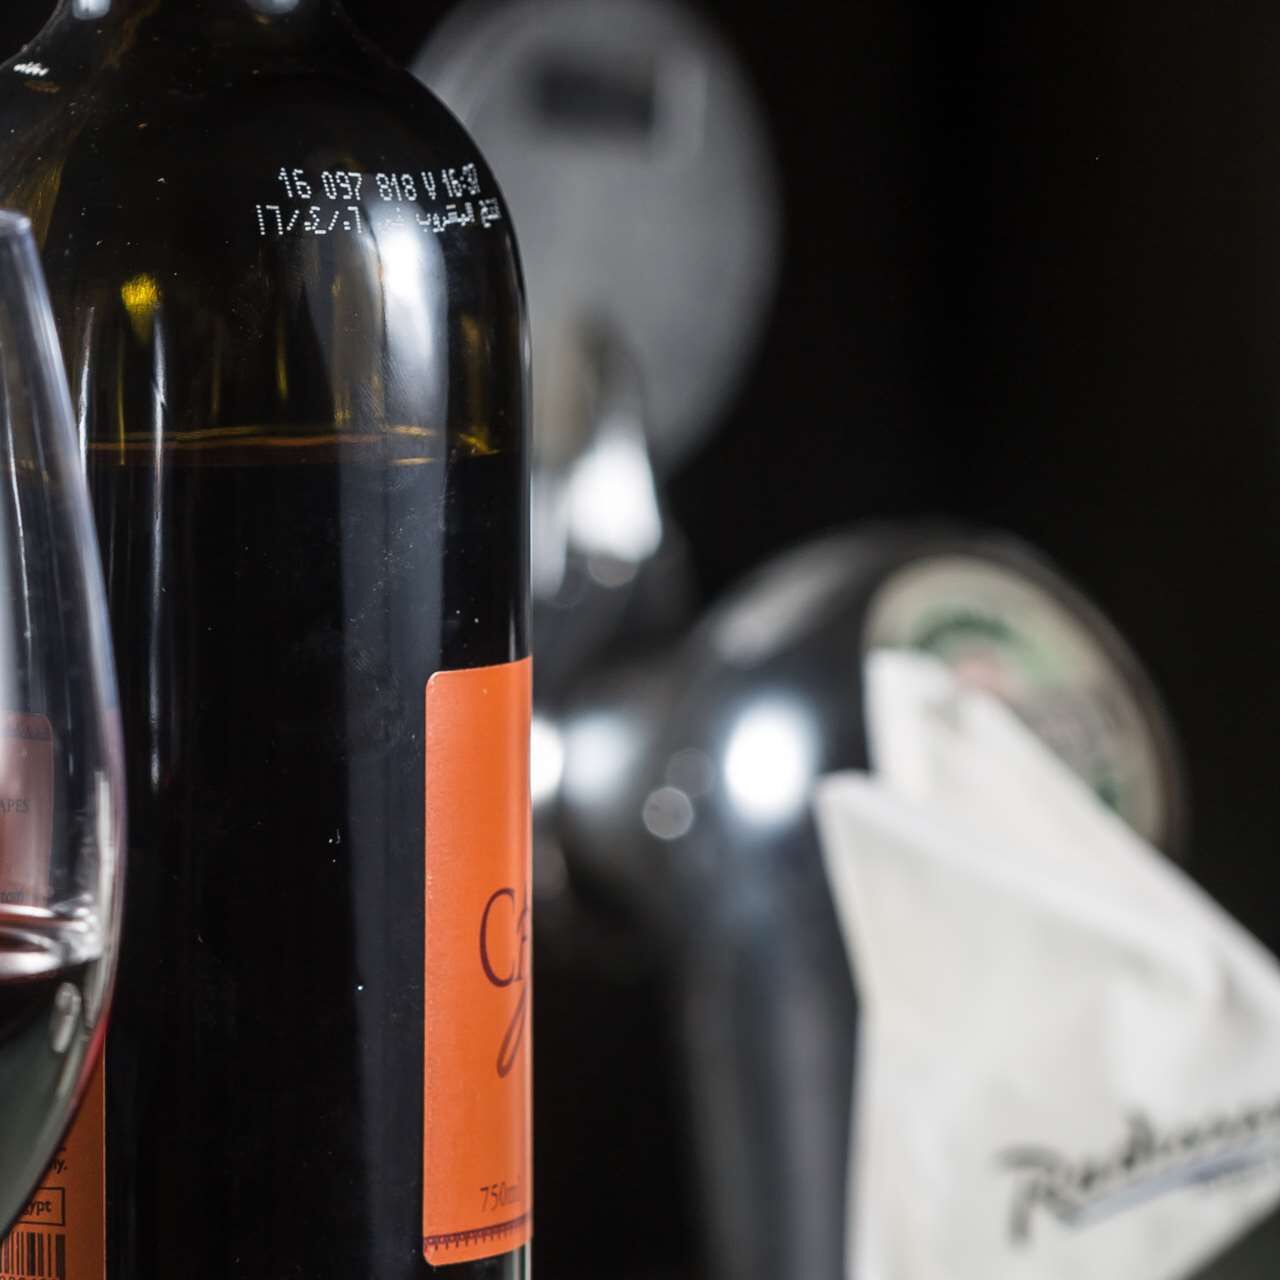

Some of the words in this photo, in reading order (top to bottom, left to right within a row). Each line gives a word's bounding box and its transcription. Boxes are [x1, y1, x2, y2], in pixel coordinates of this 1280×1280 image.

[278, 167, 311, 199] 16
[321, 171, 363, 201] 097
[375, 172, 418, 201] 818
